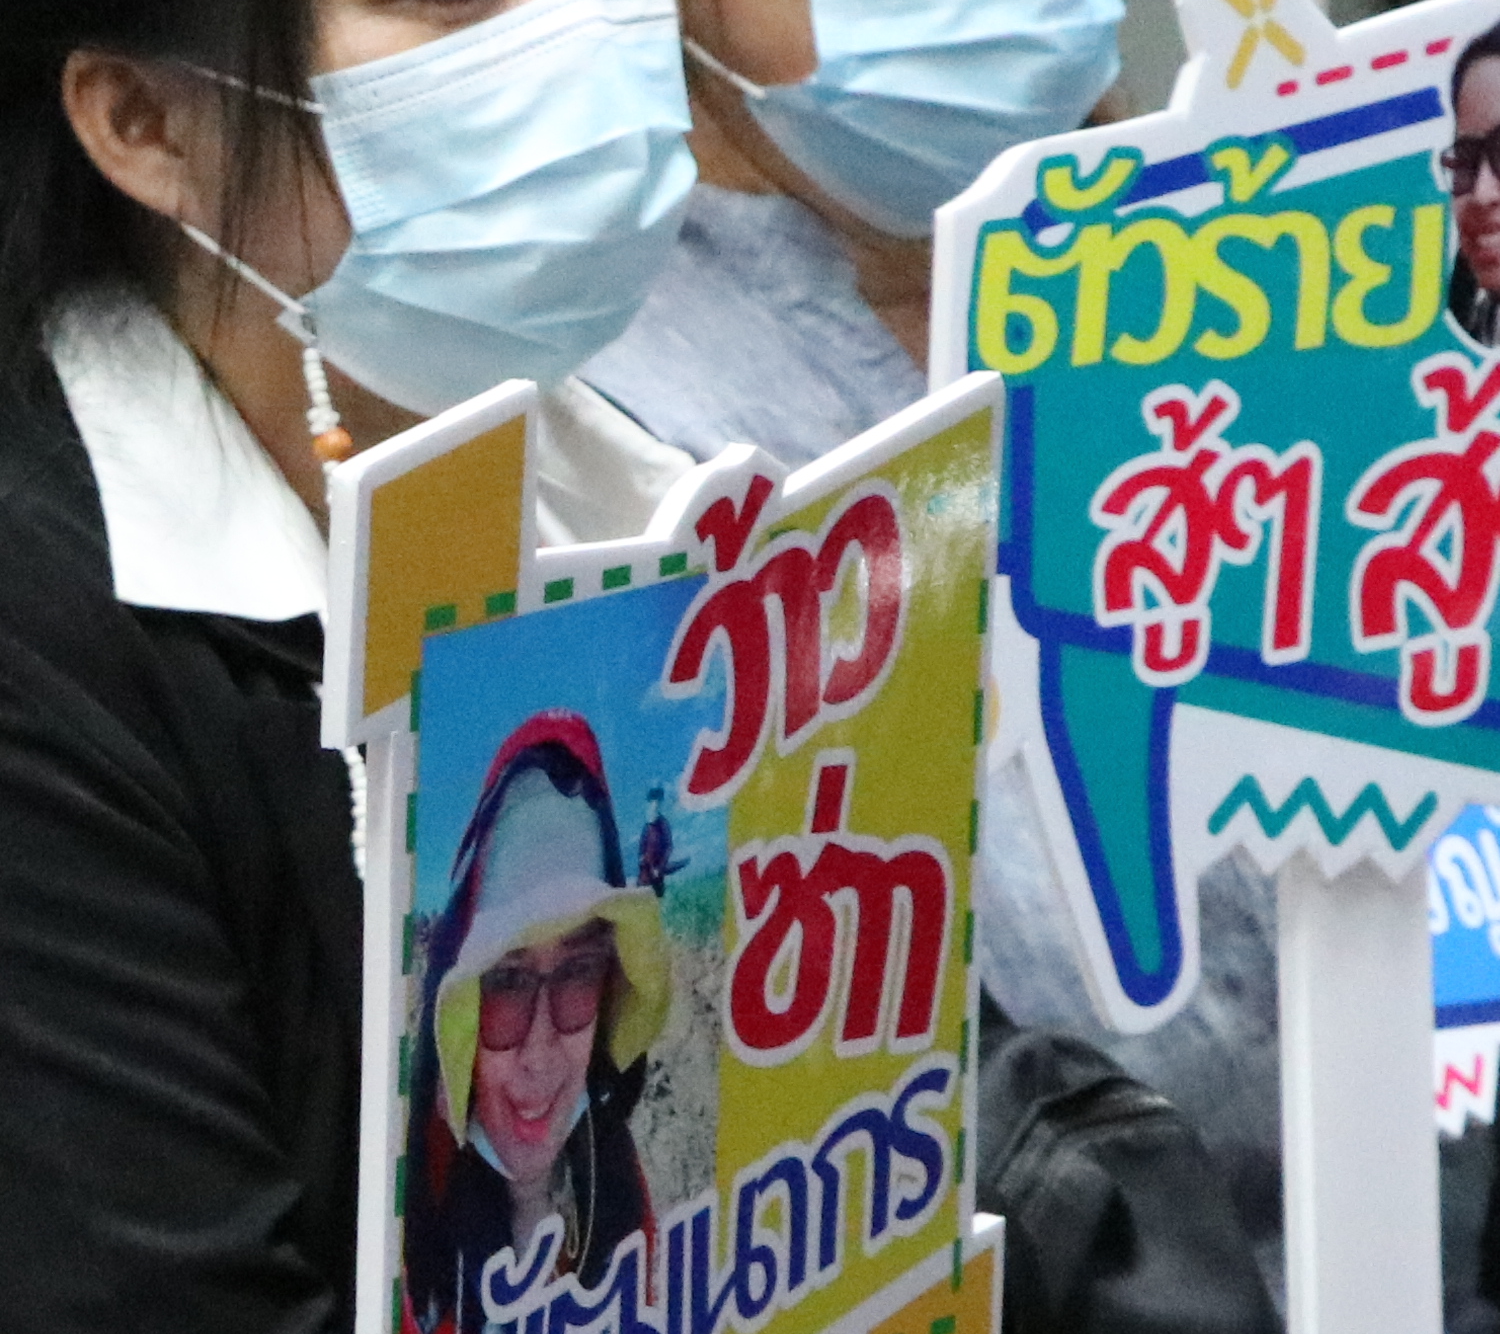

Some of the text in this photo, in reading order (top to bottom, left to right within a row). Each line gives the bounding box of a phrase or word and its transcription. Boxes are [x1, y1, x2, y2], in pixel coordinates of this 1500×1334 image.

[974, 142, 1445, 376] ตัวร้าย
[667, 472, 903, 797] ว้าว
[1099, 393, 1315, 674] สู้ๆ
[729, 762, 947, 1051] ซ่า
